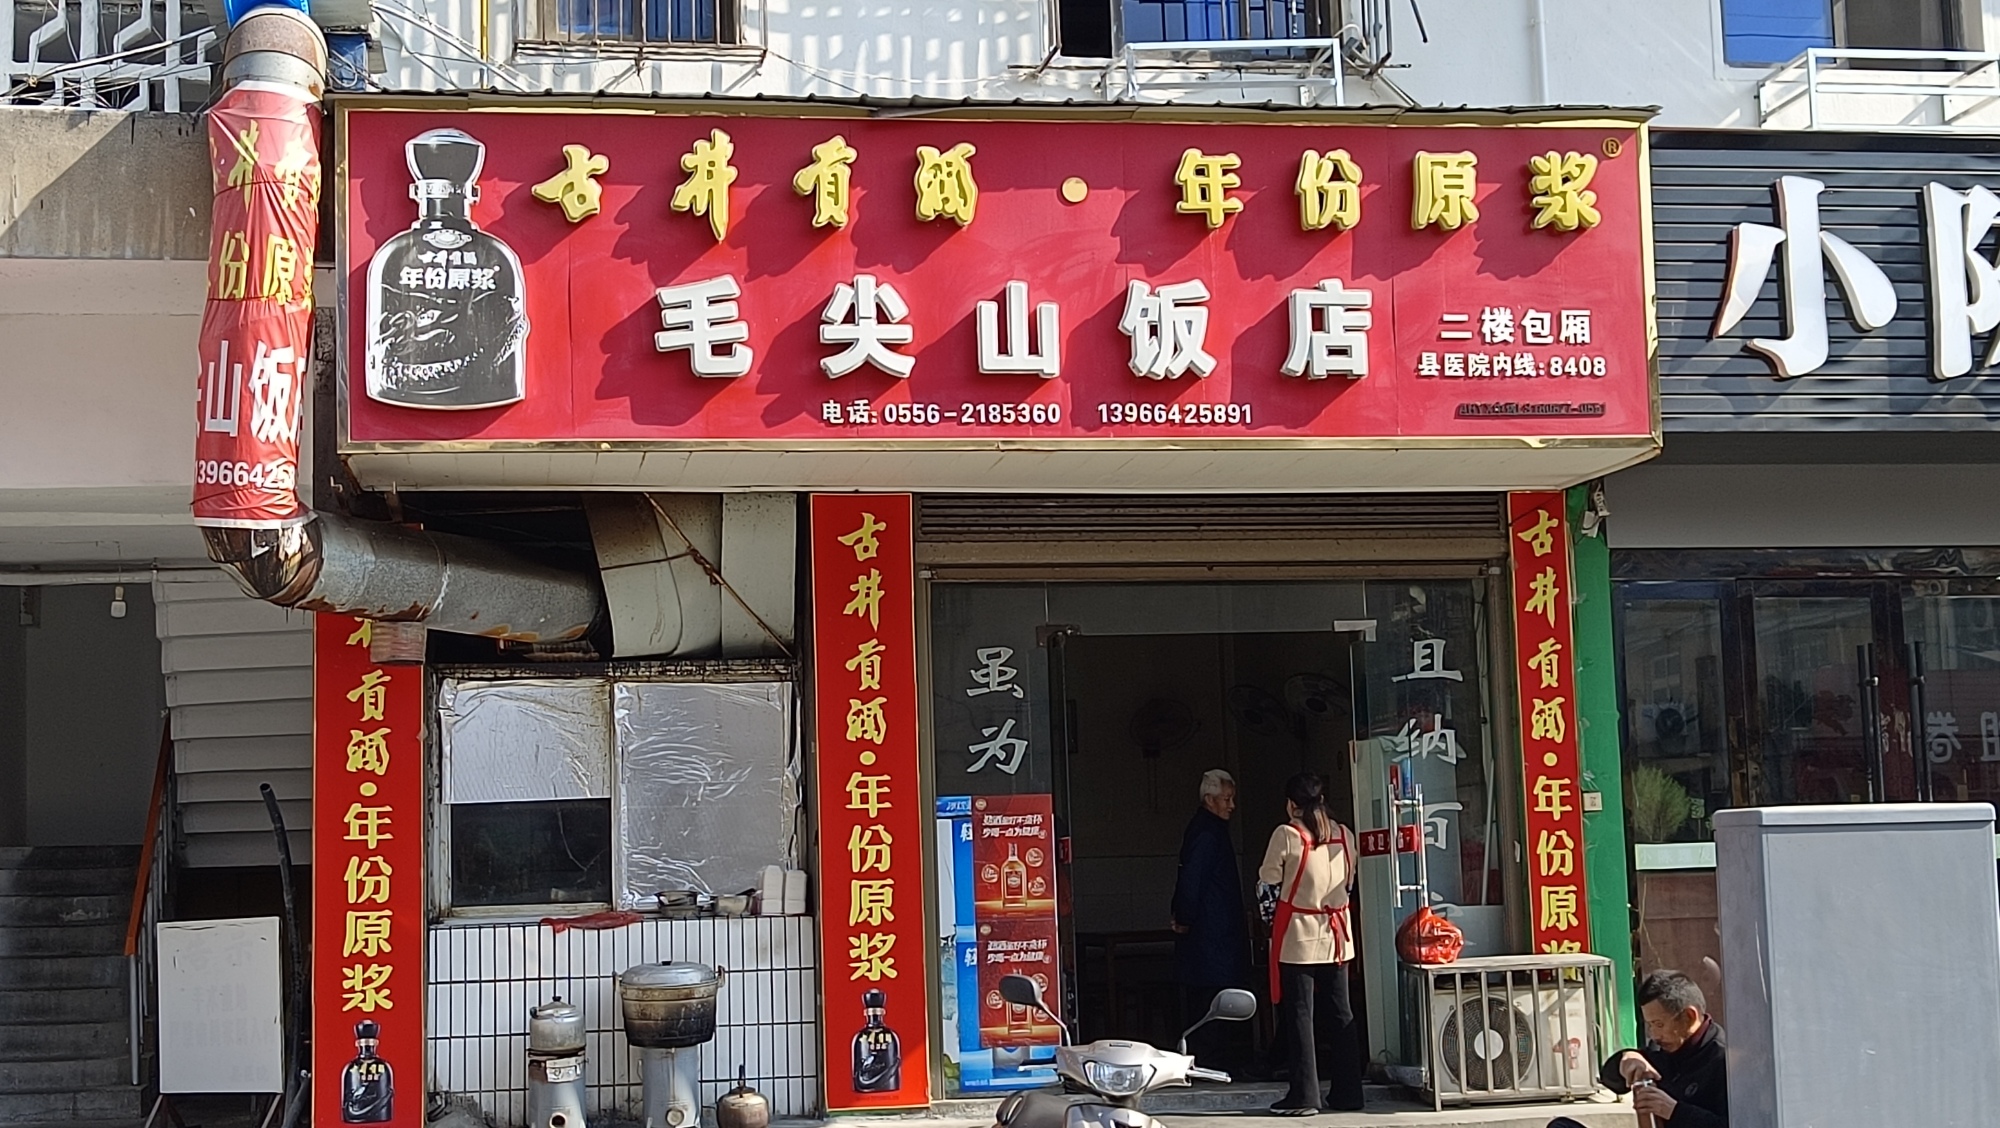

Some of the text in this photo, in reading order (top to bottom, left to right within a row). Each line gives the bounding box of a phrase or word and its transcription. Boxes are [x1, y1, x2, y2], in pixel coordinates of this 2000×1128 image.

[655, 274, 1372, 381] 毛尖山饭店
[1440, 306, 1591, 345] 二楼包厢
[1418, 351, 1606, 377] 县医院内线:8408
[1098, 403, 1253, 425] 13966425891
[966, 646, 1029, 775] 虽为
